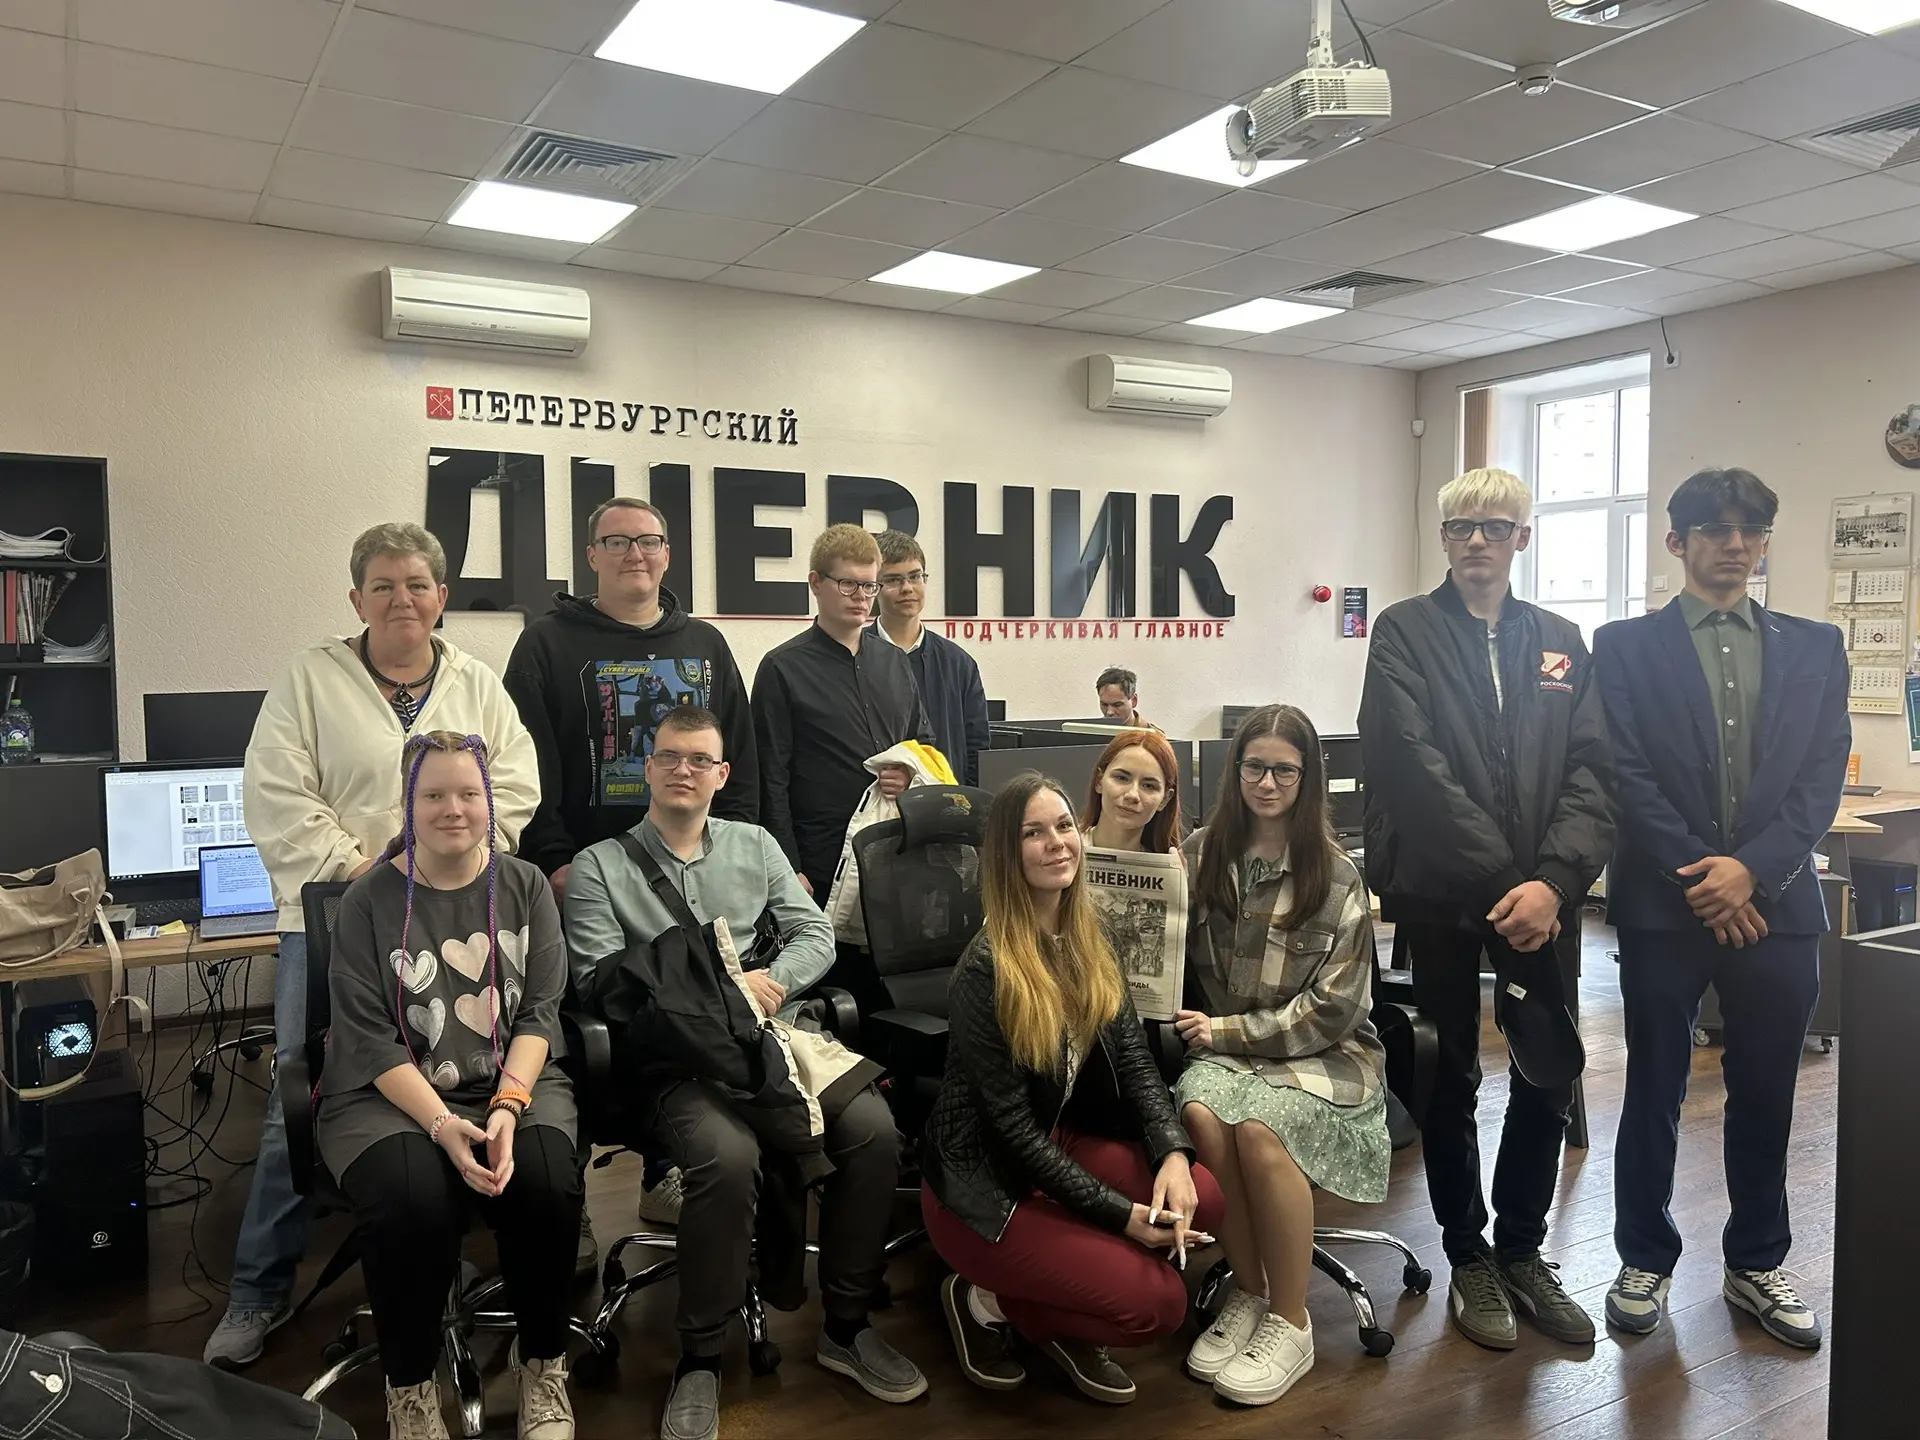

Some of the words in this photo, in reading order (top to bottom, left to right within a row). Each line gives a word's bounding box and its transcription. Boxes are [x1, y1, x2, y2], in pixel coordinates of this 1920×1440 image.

[458, 387, 799, 445] ПЕТЕРБУРГСКИЙ
[945, 621, 1119, 642] ПОДЧЕРКИВАЯ
[1134, 622, 1225, 639] ГЛАВНОЕ
